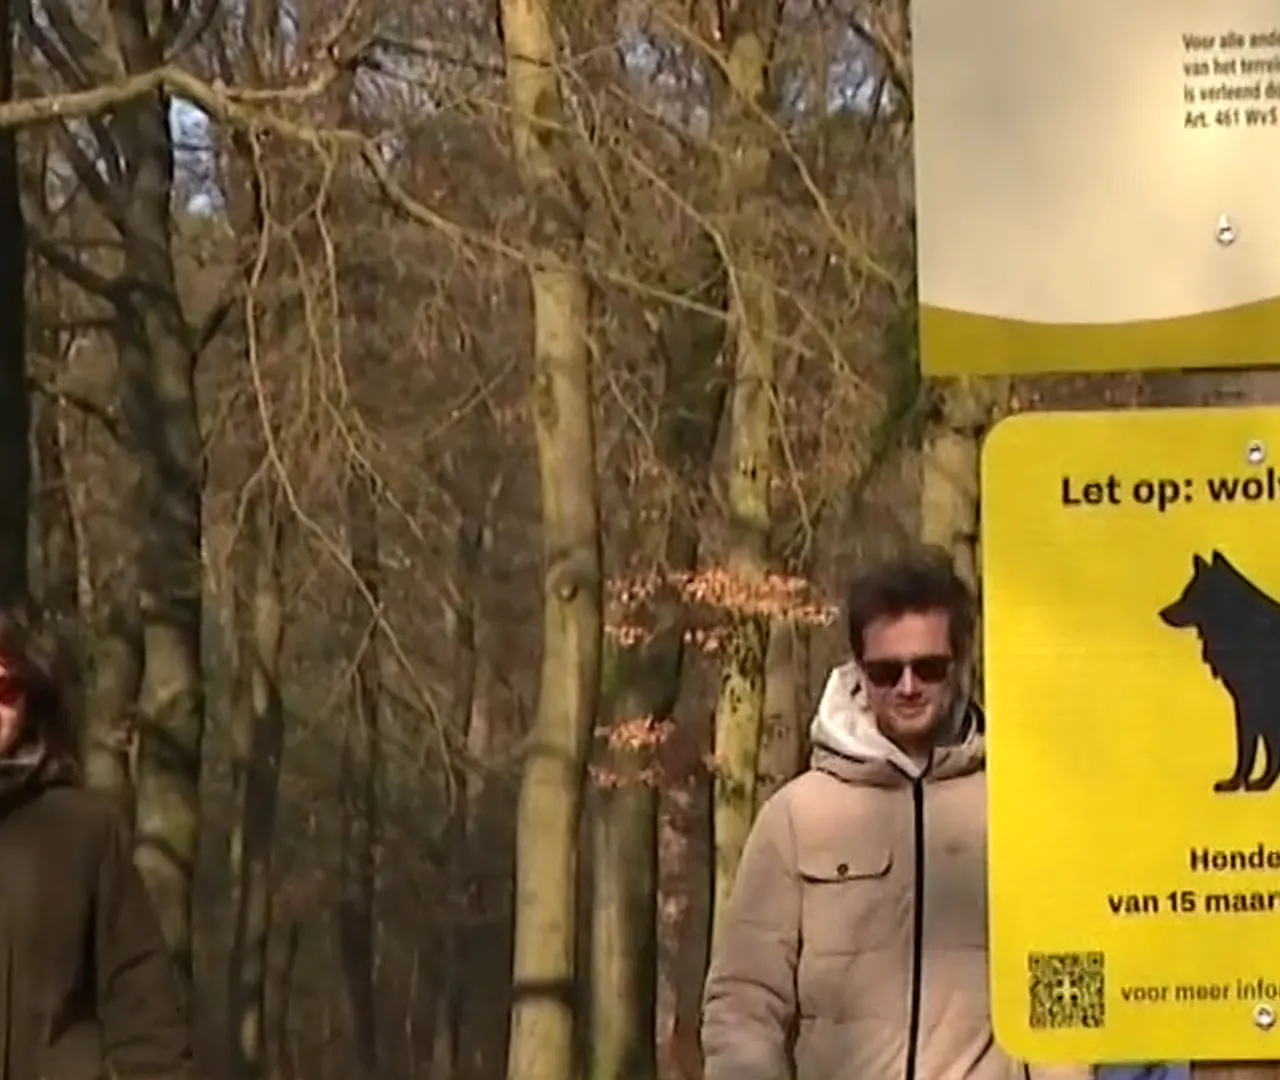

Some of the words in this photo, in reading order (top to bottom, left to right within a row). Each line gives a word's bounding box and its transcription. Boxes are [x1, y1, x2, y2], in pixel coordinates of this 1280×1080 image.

[1182, 32, 1215, 50] Voor
[1220, 30, 1245, 48] alle
[1183, 62, 1209, 76] van
[1213, 57, 1237, 75] het
[1184, 84, 1195, 103] is
[1200, 81, 1261, 101] verleend
[1184, 110, 1210, 128] Art.
[1215, 107, 1240, 127] 461
[1245, 106, 1278, 126] WvS
[1061, 475, 1121, 506] Let
[1132, 476, 1193, 513] op:
[1108, 892, 1159, 915] van
[1166, 890, 1196, 914] 15
[1121, 985, 1168, 1002] voor
[1175, 984, 1229, 1001] meer
